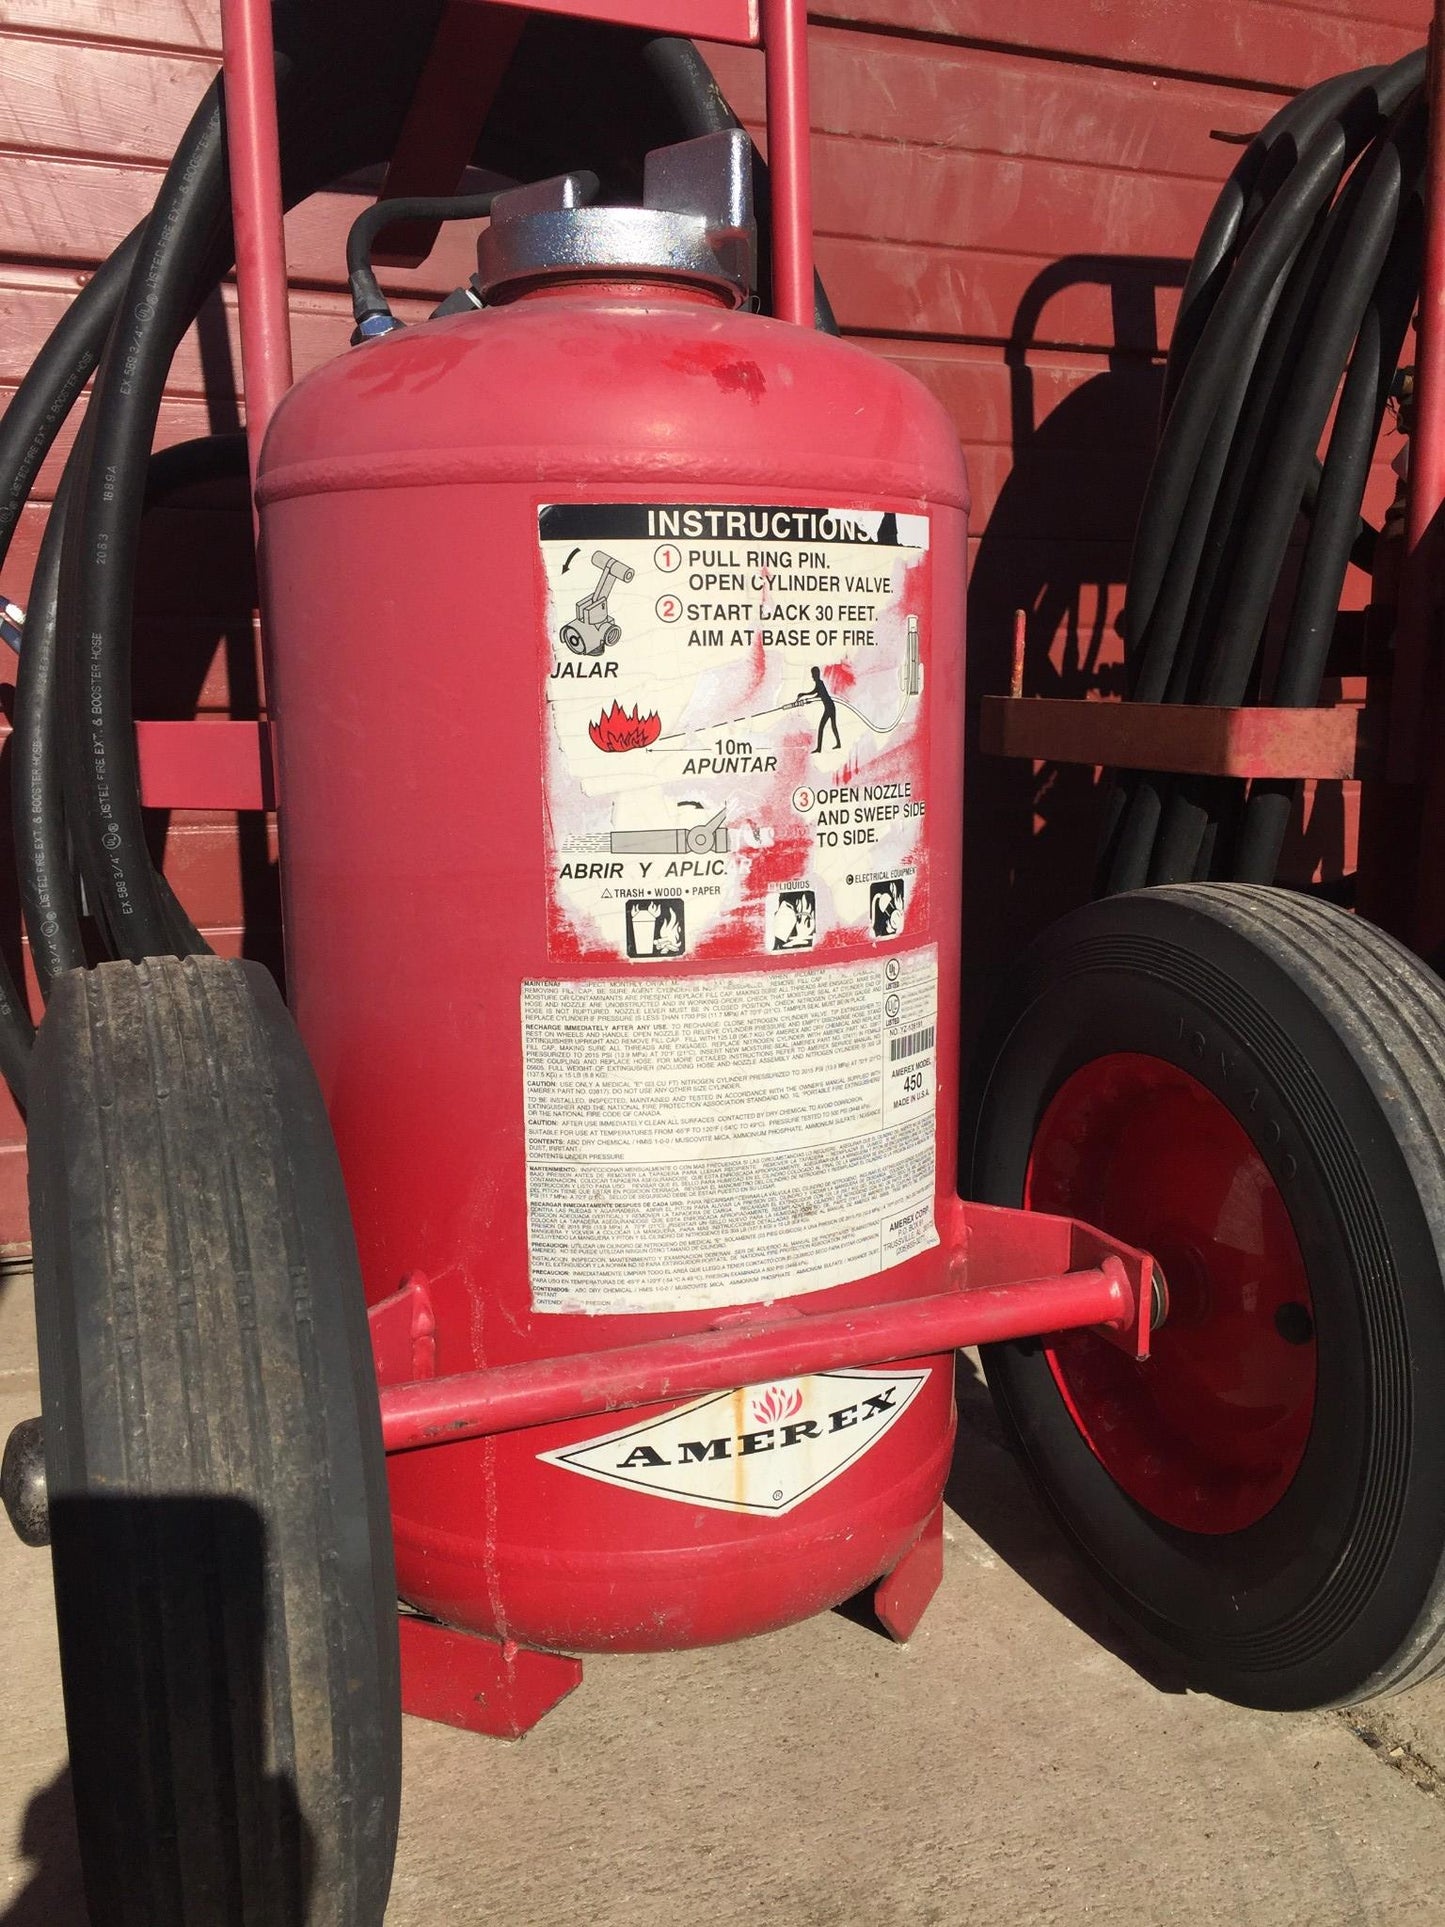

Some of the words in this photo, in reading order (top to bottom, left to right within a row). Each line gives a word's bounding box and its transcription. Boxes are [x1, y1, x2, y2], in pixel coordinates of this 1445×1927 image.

[182, 133, 208, 183] BOOSTER
[178, 184, 189, 194] &
[158, 224, 174, 248] FIRE
[146, 252, 164, 289] LISTED
[688, 550, 740, 568] PULL
[747, 550, 792, 568] RING
[798, 552, 830, 569] PIN.
[689, 574, 744, 591] OPEN
[752, 574, 840, 592] CYLINDER
[845, 576, 894, 594] VALVE.
[686, 604, 753, 621] START
[816, 604, 834, 622] 30
[838, 605, 878, 622] FEET.
[91, 632, 102, 660] HOSE
[688, 630, 724, 647] AIM
[730, 630, 754, 646] AT
[762, 630, 810, 646] BASE
[816, 630, 838, 646] OF
[842, 630, 878, 646] FIRE.
[550, 662, 618, 678] JALAR
[91, 664, 102, 714] BOOSTER
[92, 718, 103, 726] &
[32, 741, 43, 766] HOSE
[714, 739, 752, 756] 10m
[96, 760, 106, 780] FIRE
[682, 757, 778, 775] APUNTAR
[32, 770, 42, 814] BOOSTER
[816, 788, 858, 804] OPEN
[864, 782, 911, 802] NOZZLE
[32, 814, 43, 824] &
[816, 810, 855, 826] AND
[854, 805, 900, 824] SWEEP
[904, 800, 926, 818] SIDE
[816, 832, 838, 848] TO
[843, 828, 878, 846] SIDE.
[36, 852, 45, 874] FIRE
[559, 863, 624, 878] ABRIR
[639, 862, 652, 878] Y
[779, 880, 810, 890] LIQUIDS
[855, 872, 889, 884] ELECTRICAL
[890, 867, 916, 879] EQUIPMEN
[36, 874, 50, 908] LISTED
[614, 888, 644, 898] TRASH
[654, 888, 682, 898] WOOD
[692, 886, 720, 896] PAPER
[122, 900, 134, 915] EX
[892, 1064, 915, 1078] AMEREX
[904, 1072, 922, 1092] 450
[893, 1096, 910, 1109] MADE
[910, 1094, 916, 1104] IN
[616, 1386, 896, 1468] AMEREX
